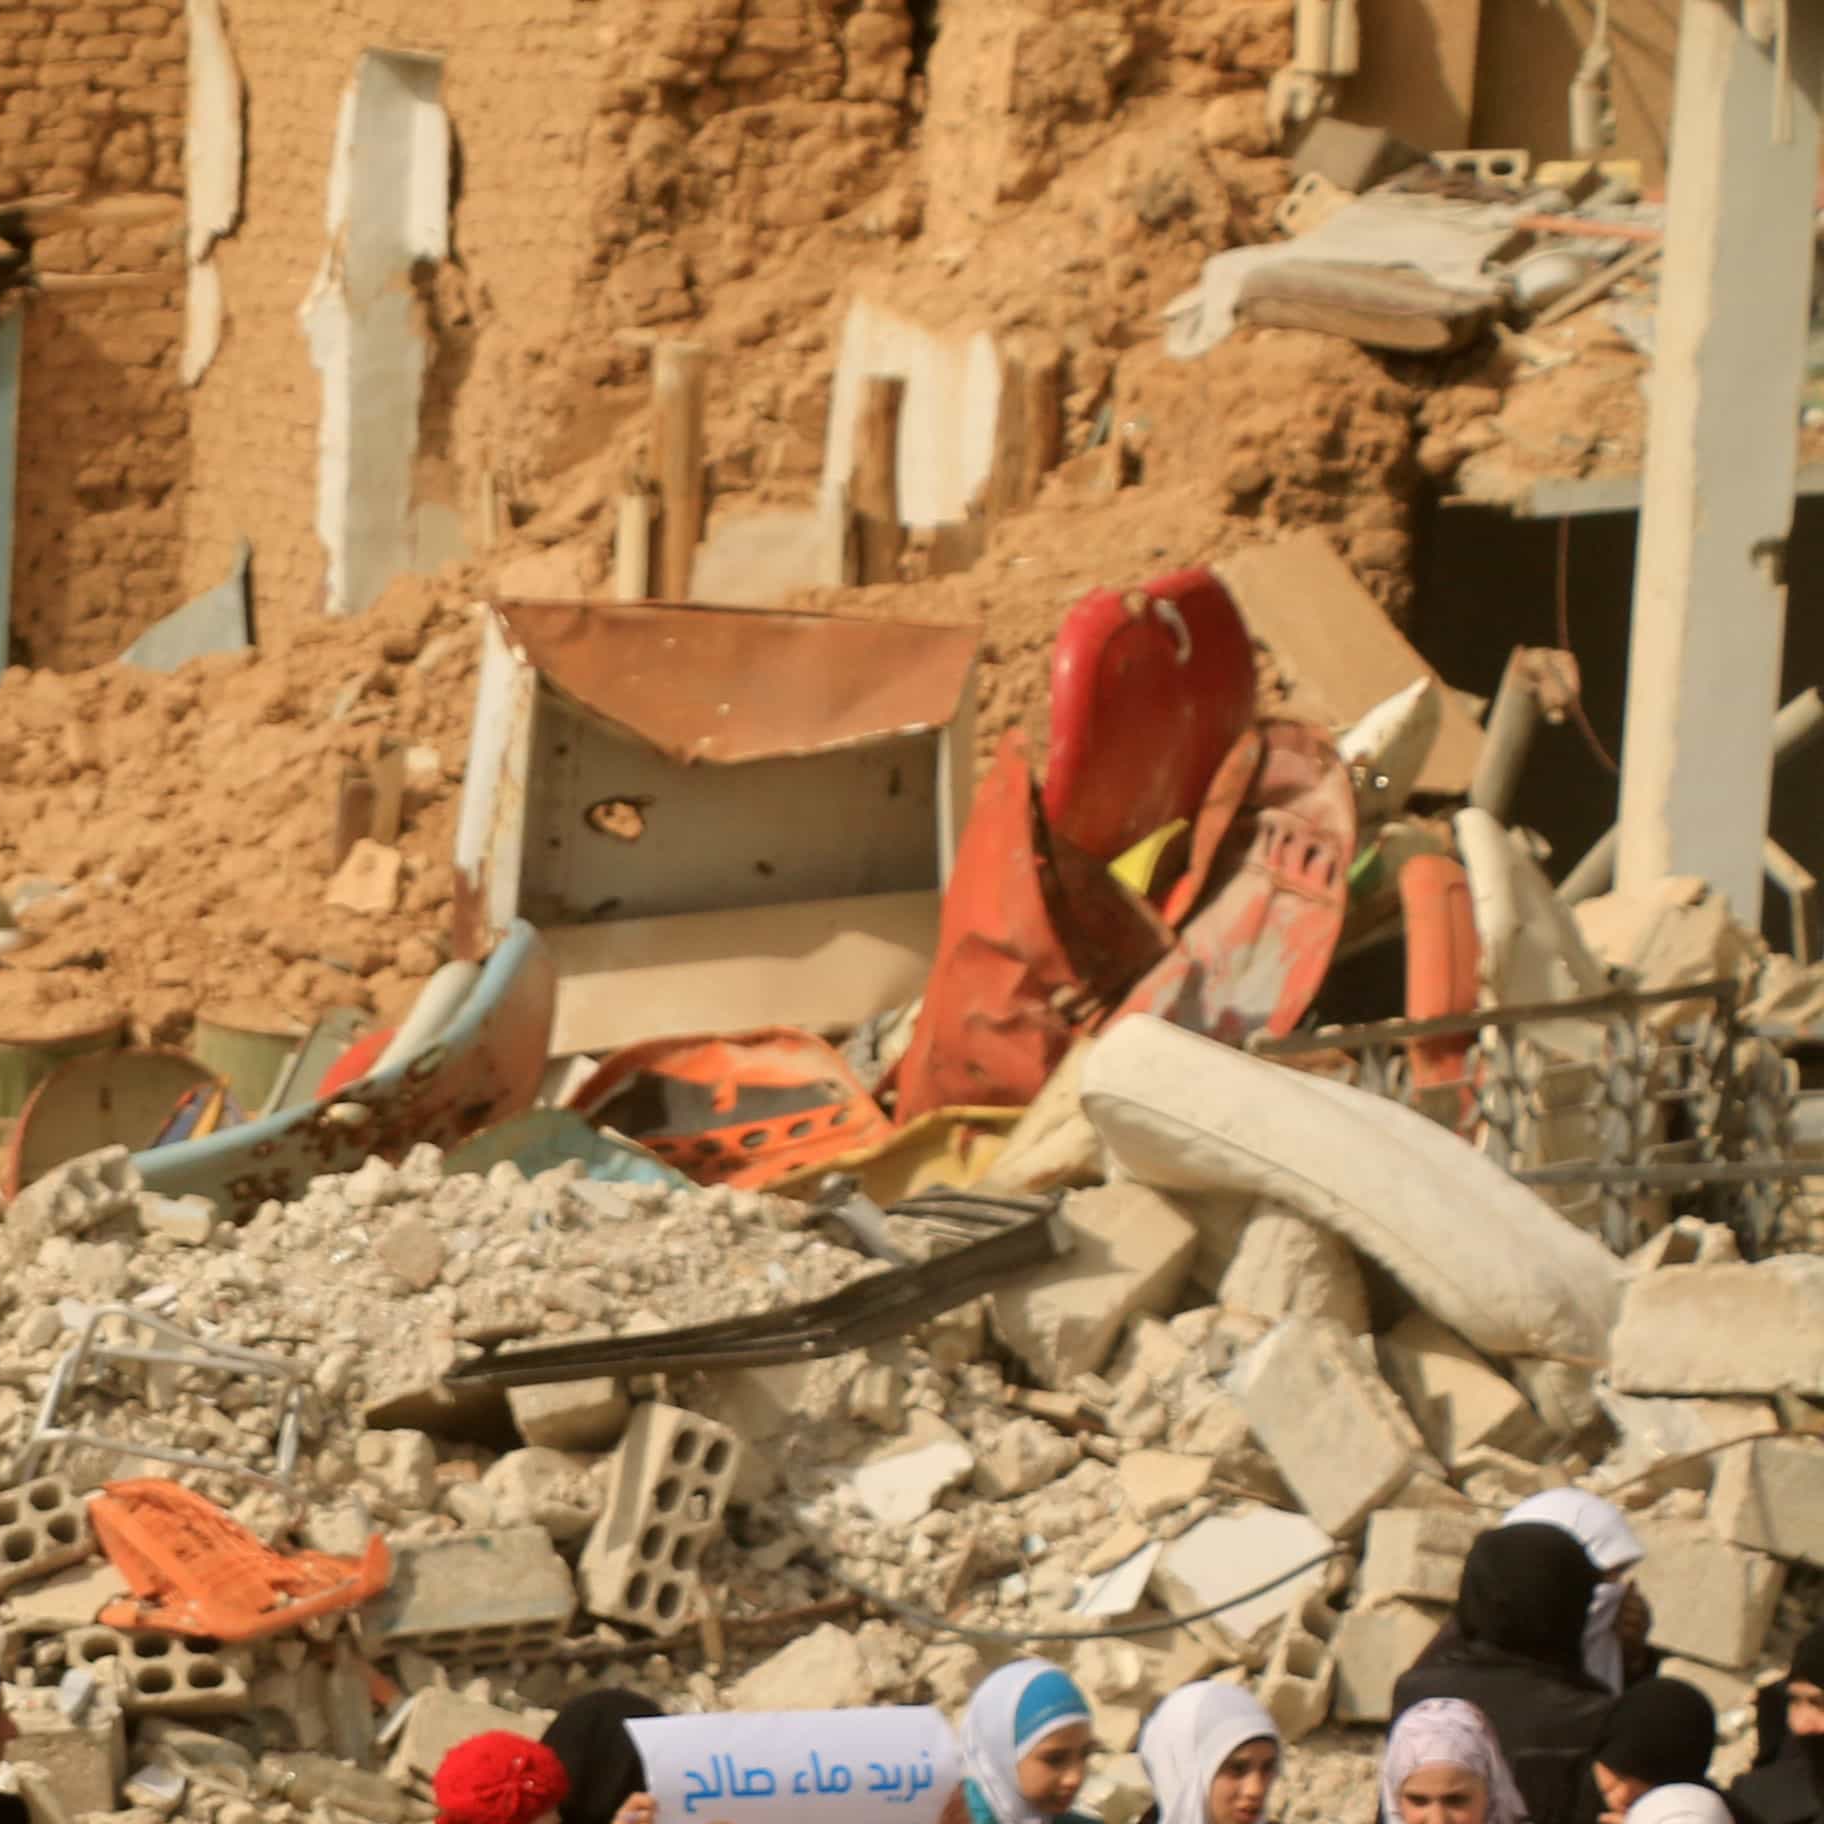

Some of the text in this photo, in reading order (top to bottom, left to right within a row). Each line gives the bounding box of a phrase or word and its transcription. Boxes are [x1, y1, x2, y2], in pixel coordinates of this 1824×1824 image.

[683, 1750, 935, 1814] نريد ماء صالح
